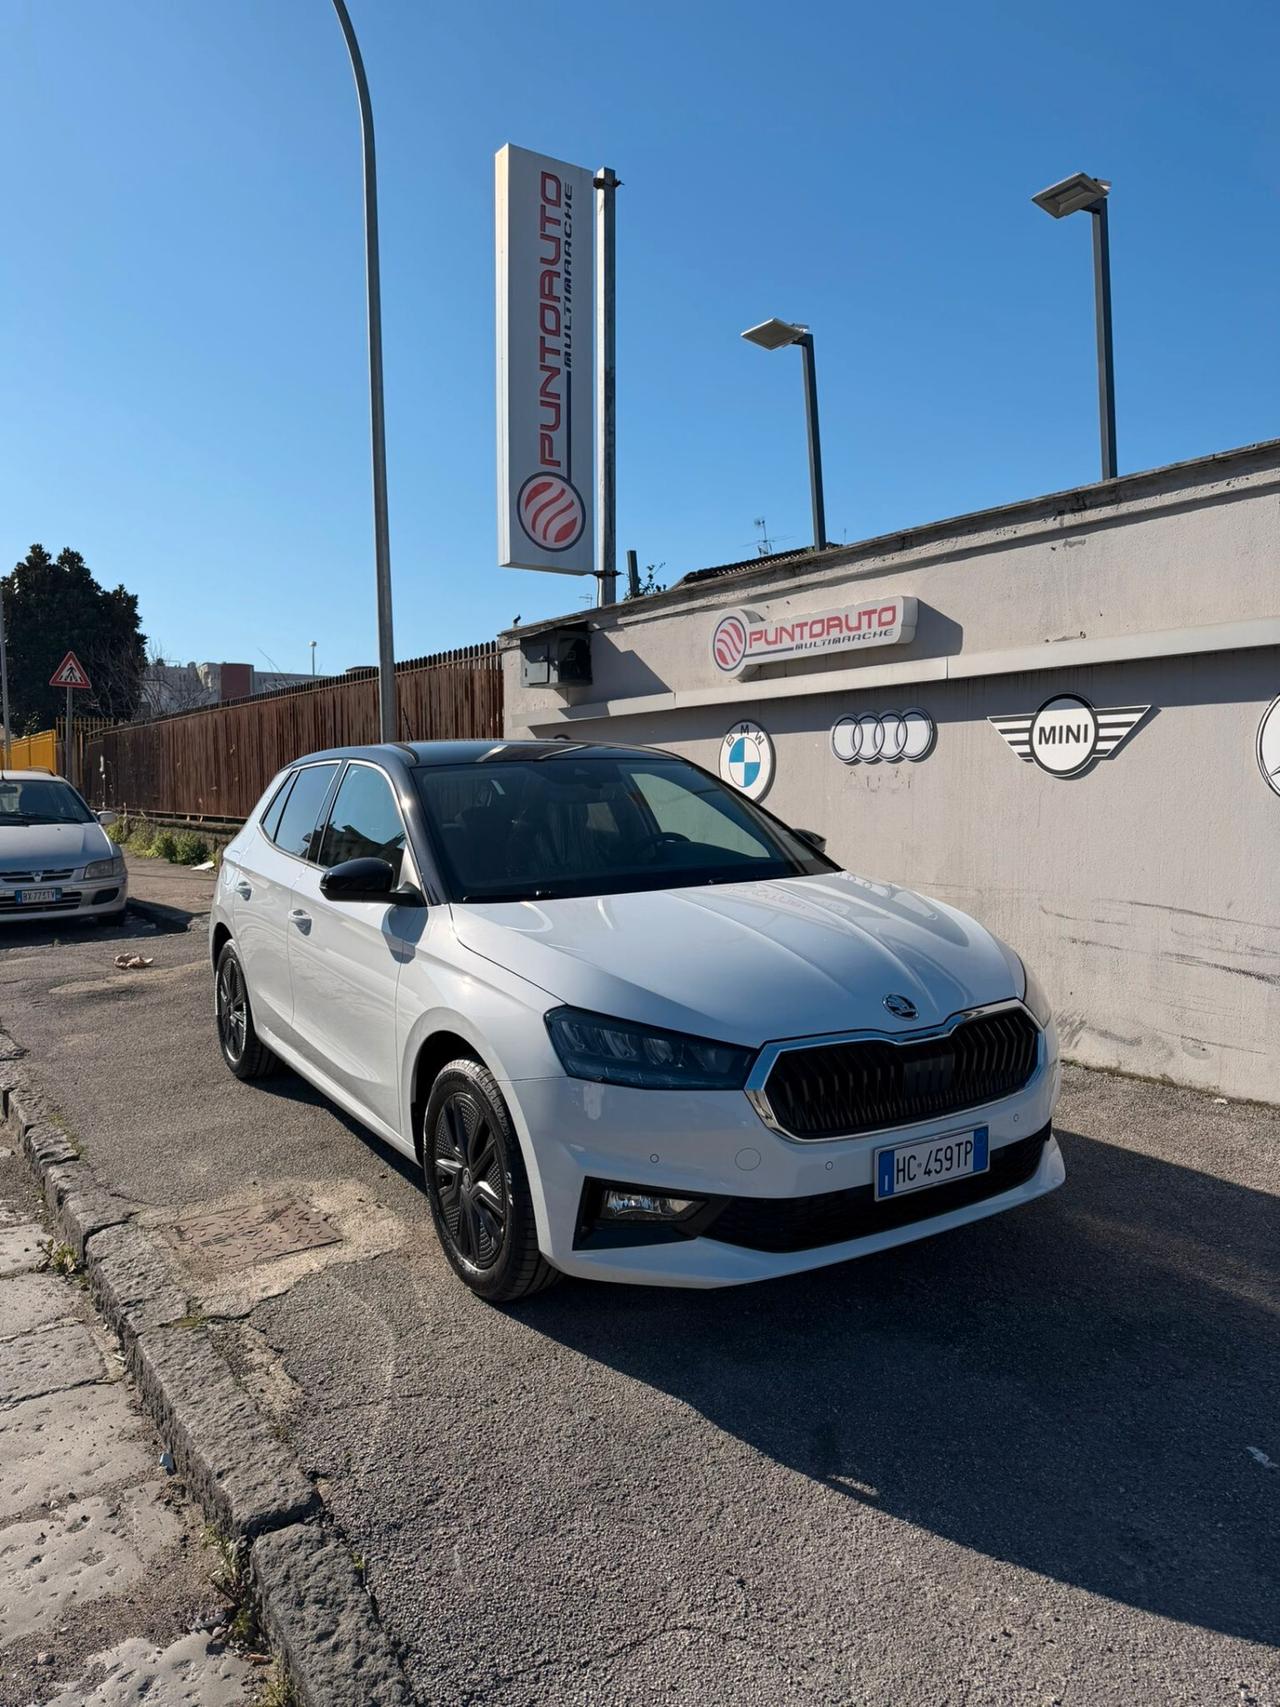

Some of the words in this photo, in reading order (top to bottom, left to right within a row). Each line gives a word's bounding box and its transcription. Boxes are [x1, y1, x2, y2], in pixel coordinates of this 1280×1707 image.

[564, 182, 573, 368] MULTIMARCHE
[540, 171, 562, 467] PUNTOAUTO
[749, 605, 897, 648] PUNTOAUTO
[795, 628, 895, 651] MULTIMARCHE
[726, 724, 765, 747] BMW
[1039, 724, 1088, 745] MINI
